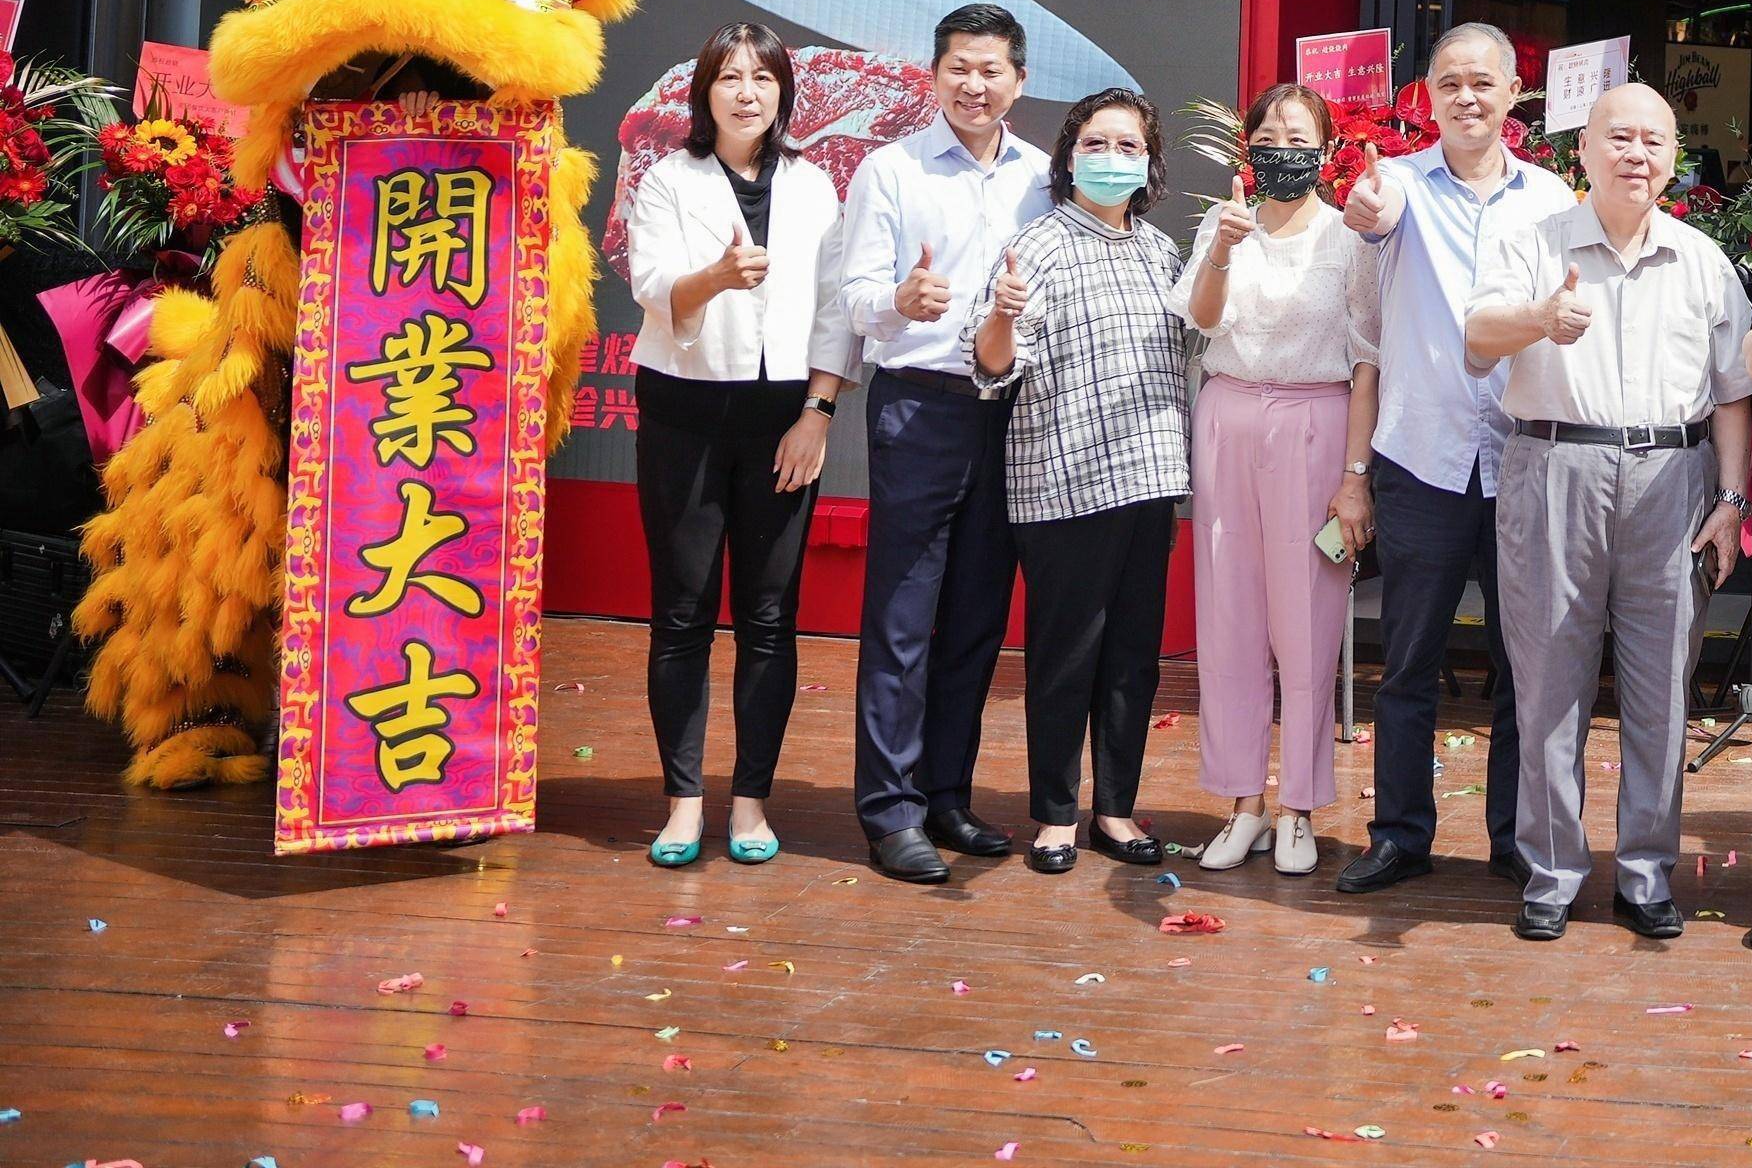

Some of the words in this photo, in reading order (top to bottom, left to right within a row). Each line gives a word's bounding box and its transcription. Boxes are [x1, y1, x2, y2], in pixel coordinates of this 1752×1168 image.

[1305, 68, 1342, 83] 开业大吉
[1347, 62, 1385, 78] 生意兴隆
[1664, 63, 1721, 103] Highball
[344, 166, 496, 793] 開業大吉
